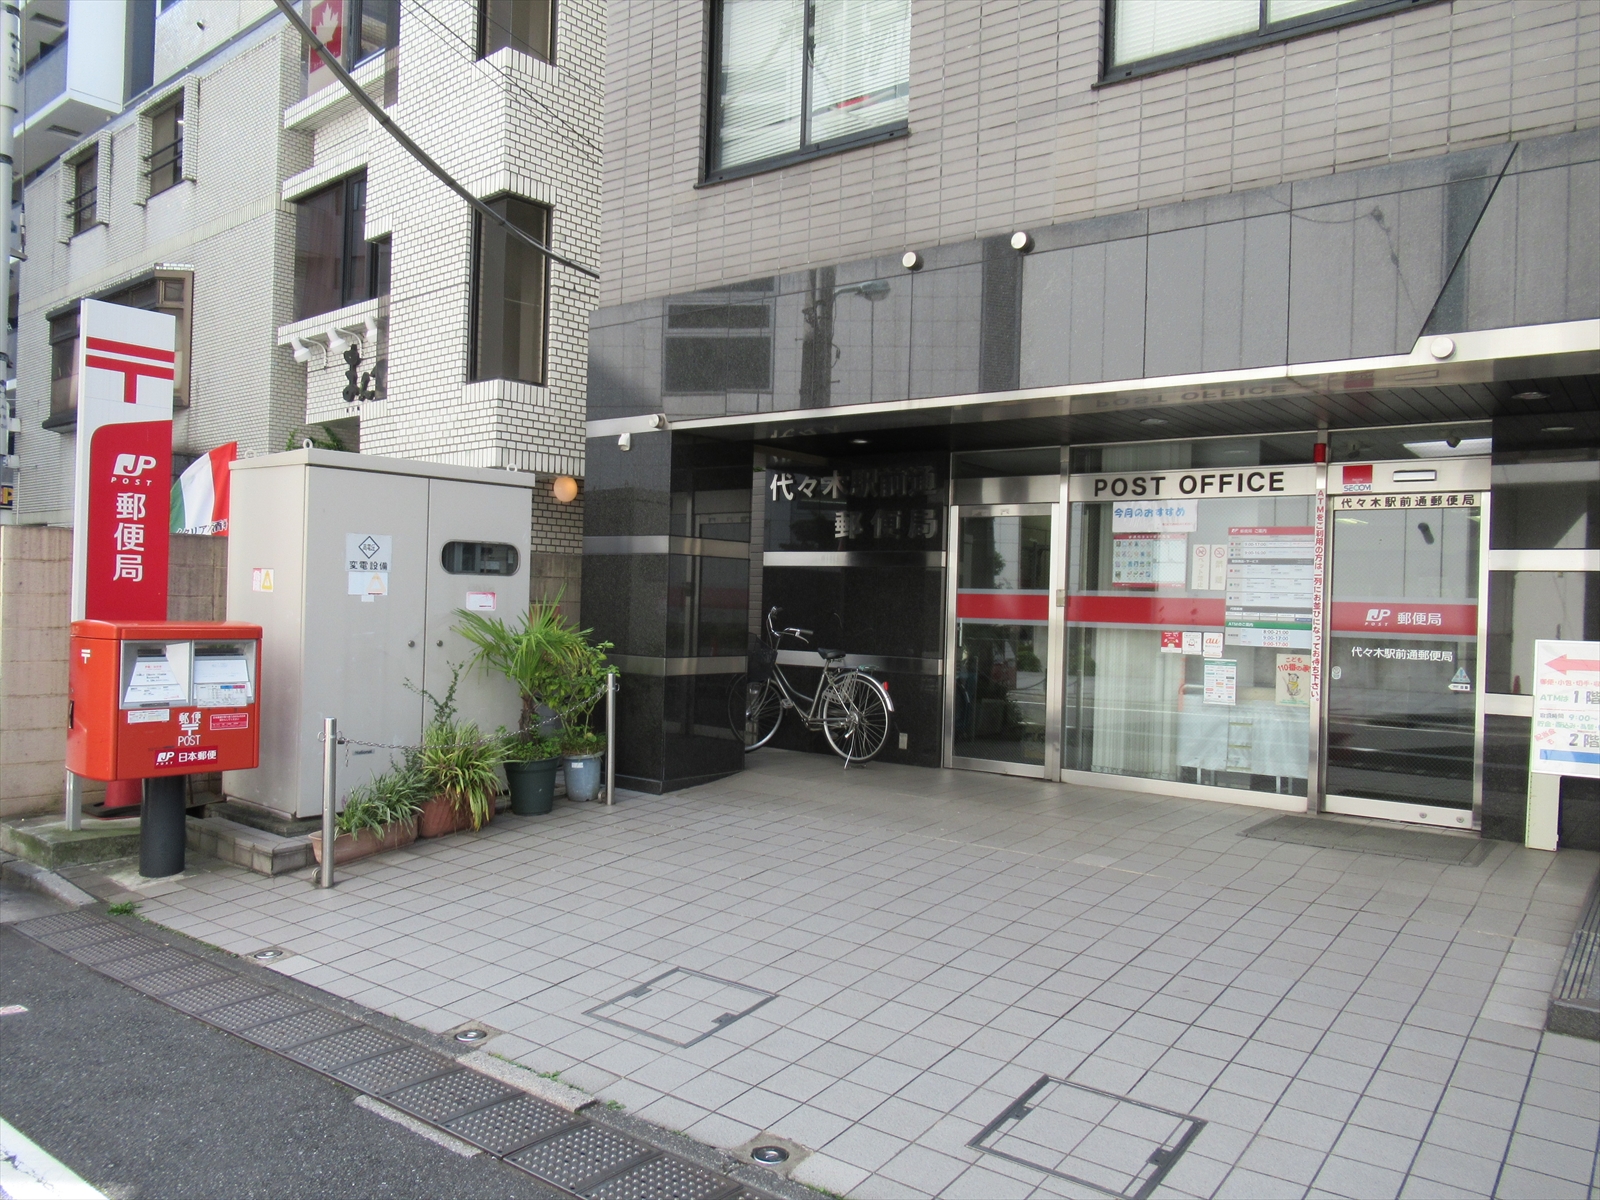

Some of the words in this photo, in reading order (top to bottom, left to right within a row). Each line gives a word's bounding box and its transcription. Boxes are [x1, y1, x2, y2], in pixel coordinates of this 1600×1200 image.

[110, 476, 153, 487] POST
[769, 465, 938, 502] 代々木駅前通
[1094, 476, 1166, 497] POST
[1179, 471, 1285, 494] OFFICE
[1343, 484, 1372, 492] SECOM
[1341, 494, 1475, 508] 代々木駅前通郵便局
[1114, 507, 1186, 519] 今月のおすすめ
[834, 509, 939, 540] 郵便局
[112, 491, 147, 583] 郵便局
[349, 560, 388, 571] 変電設備
[1397, 612, 1442, 626] 郵便局
[1205, 637, 1220, 645] au
[1286, 656, 1303, 664] こども
[1351, 646, 1453, 662] 代々木駅前通郵便局
[1540, 694, 1569, 703] ATMは
[178, 711, 202, 725] 郵便
[177, 734, 201, 747] POST
[178, 749, 217, 763] 日本郵便
